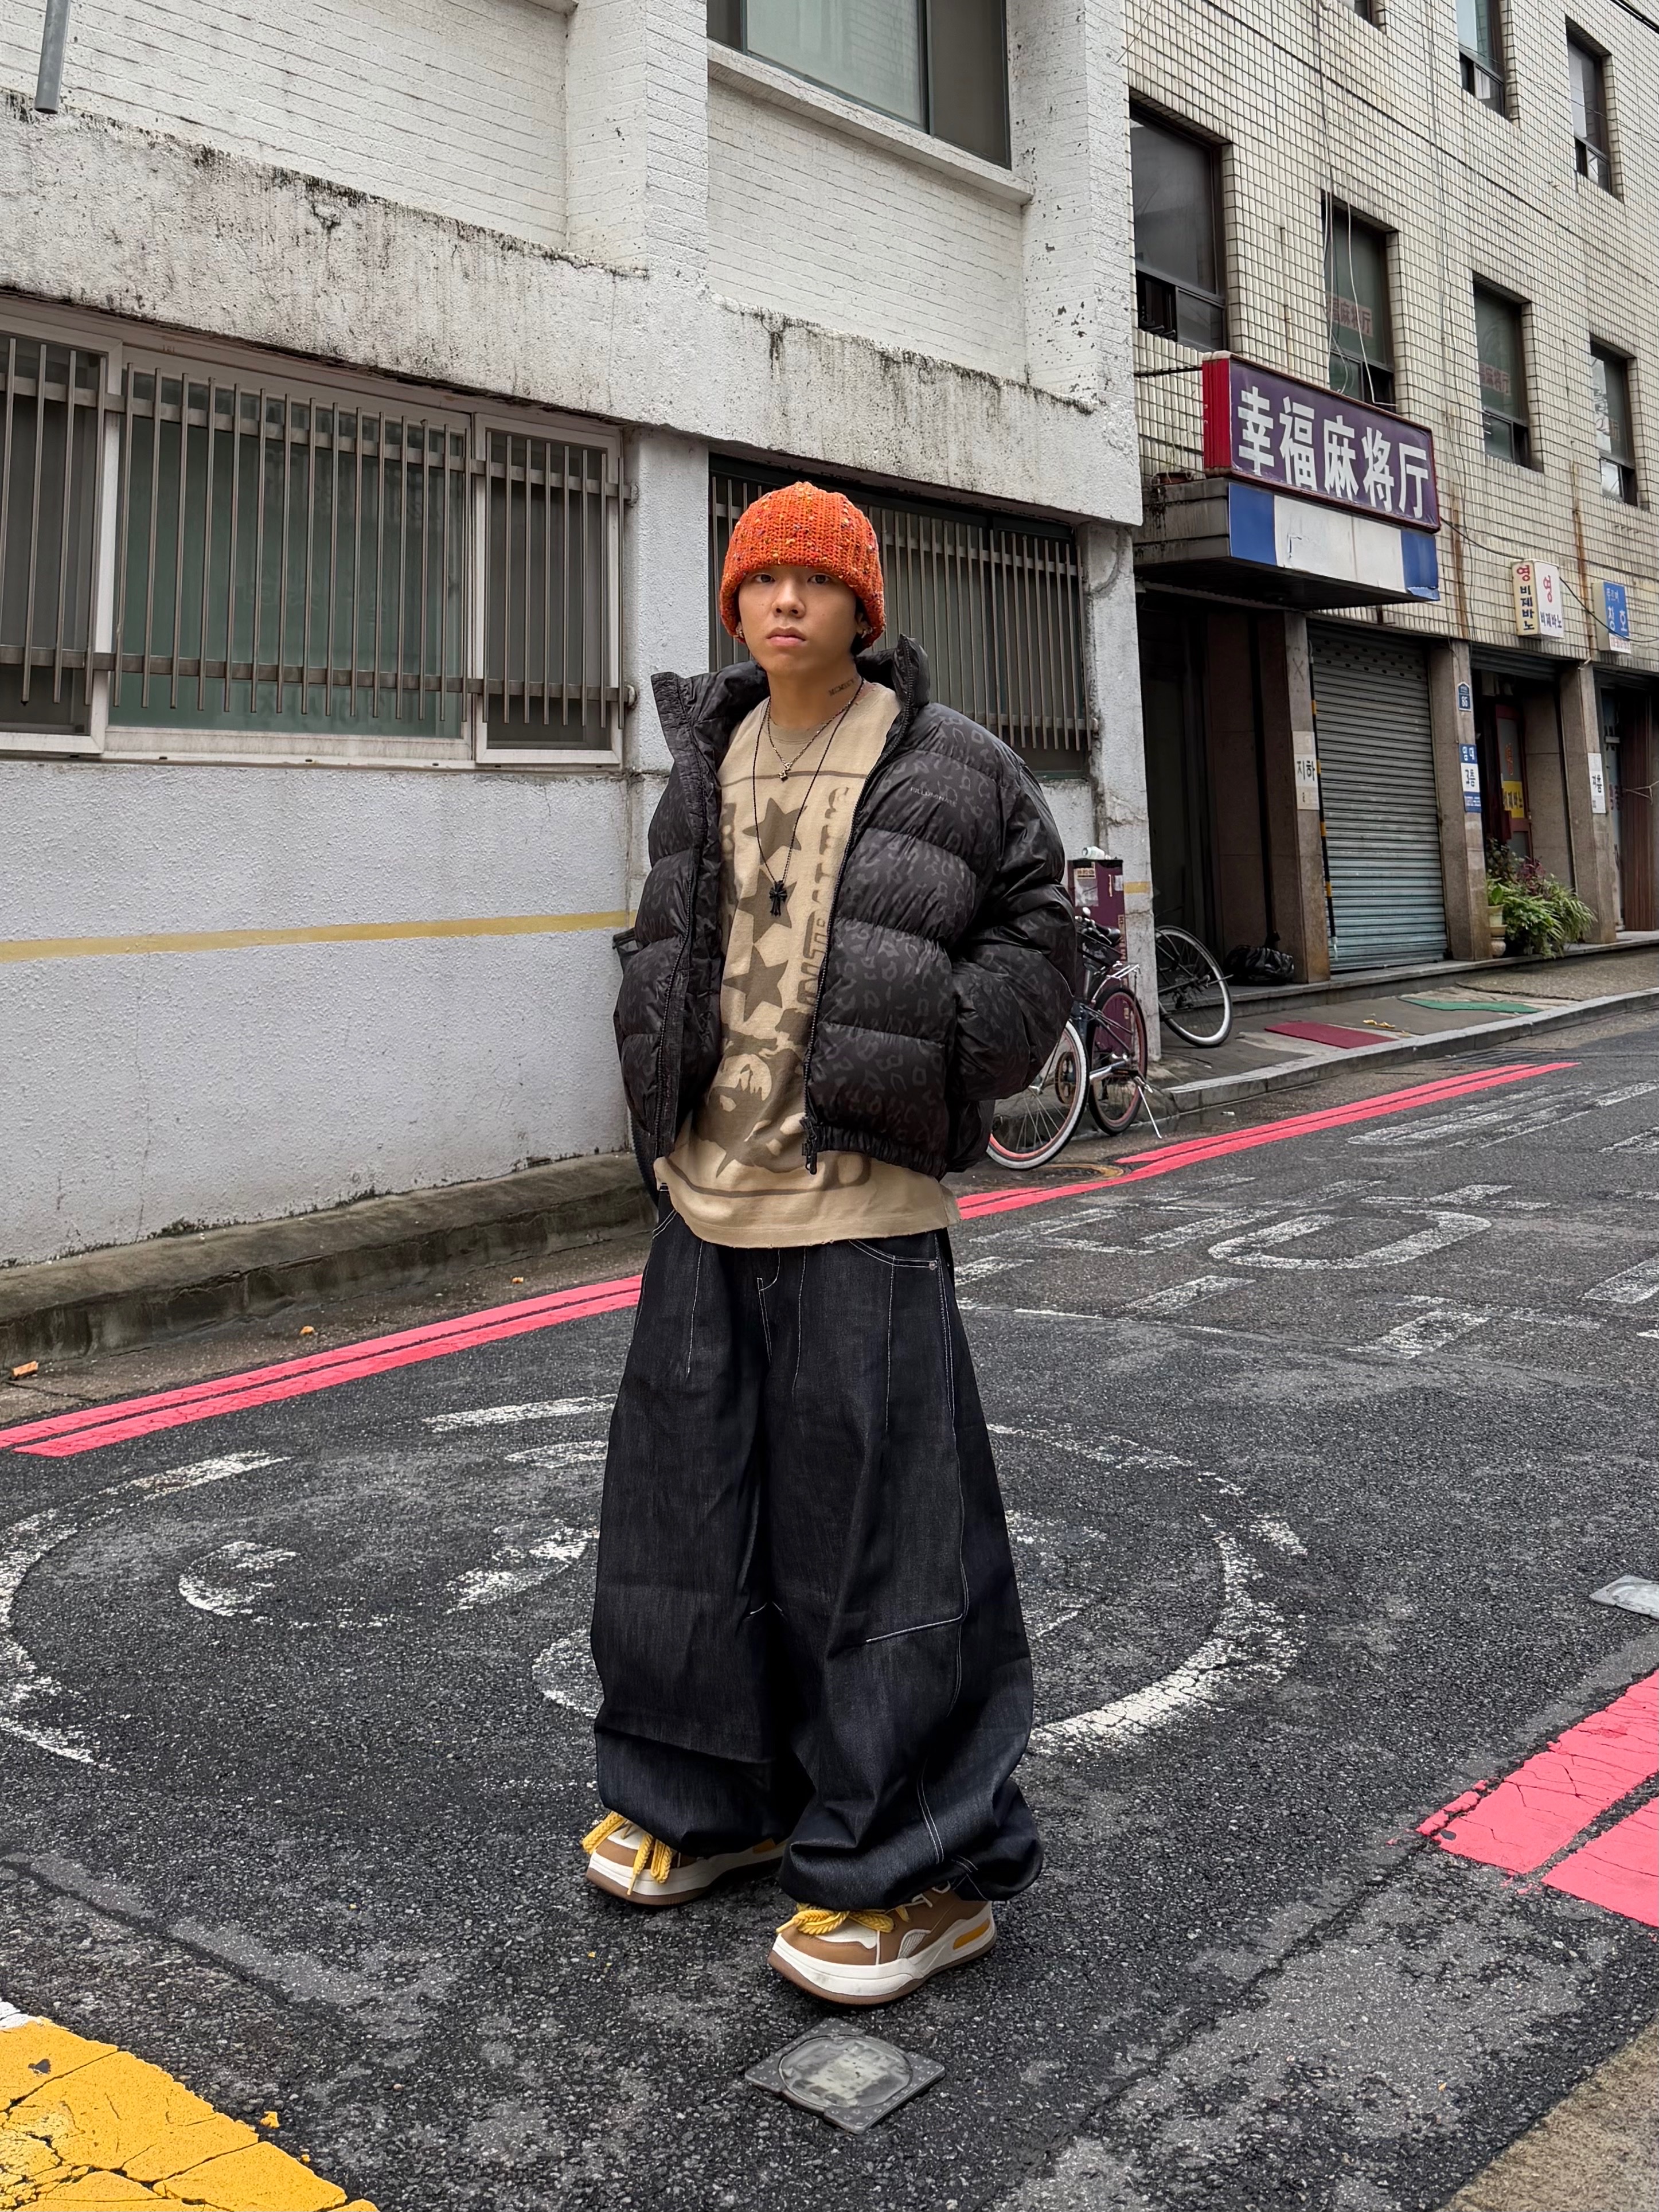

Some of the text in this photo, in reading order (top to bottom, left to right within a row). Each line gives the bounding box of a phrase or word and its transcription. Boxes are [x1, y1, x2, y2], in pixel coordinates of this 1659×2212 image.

[1238, 386, 1428, 518] 幸福麻将厅
[1516, 564, 1531, 582] 영
[1543, 575, 1552, 603] 영
[1520, 585, 1535, 630] 비제바노
[1540, 611, 1562, 629] 비제바노
[1297, 760, 1315, 781] 지하
